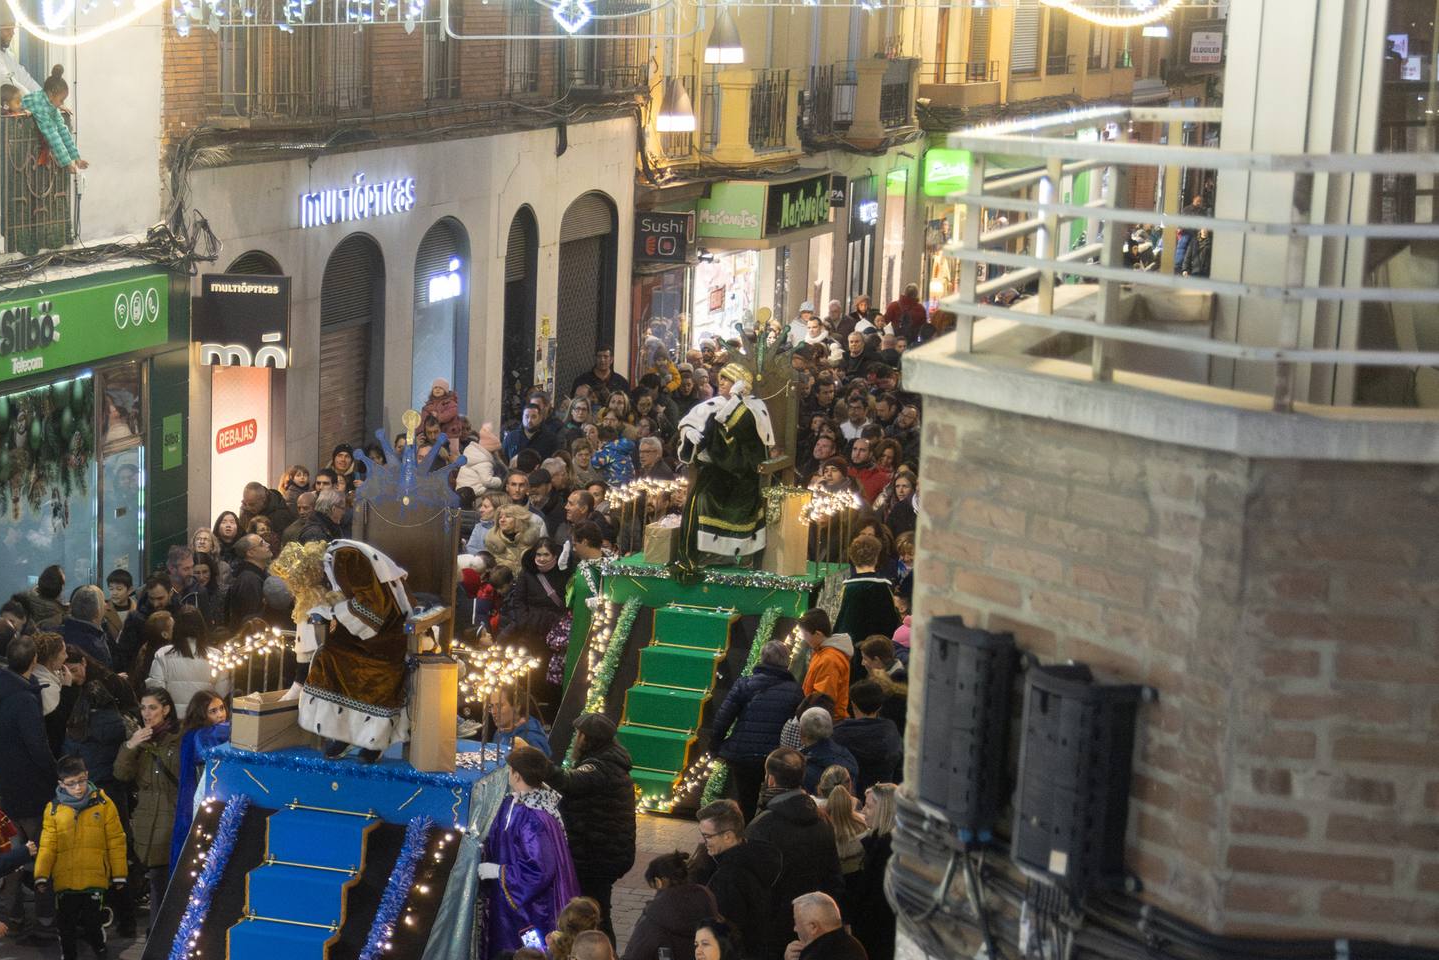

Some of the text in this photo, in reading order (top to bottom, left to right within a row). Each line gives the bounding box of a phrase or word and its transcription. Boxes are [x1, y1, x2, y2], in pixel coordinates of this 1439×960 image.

[641, 218, 684, 234] Sushi
[11, 356, 44, 375] Telecom
[218, 423, 255, 450] REBAJAS
